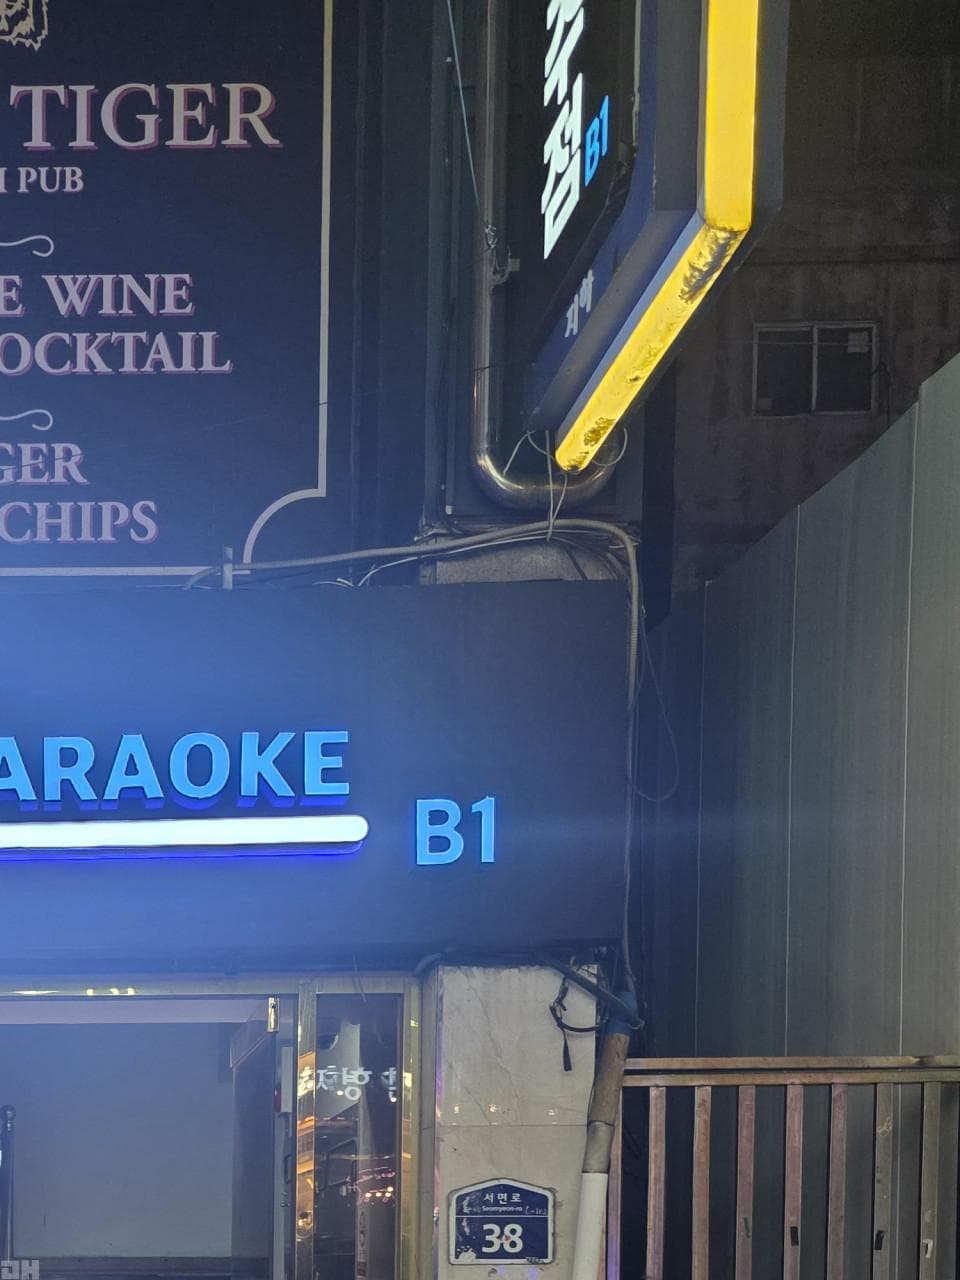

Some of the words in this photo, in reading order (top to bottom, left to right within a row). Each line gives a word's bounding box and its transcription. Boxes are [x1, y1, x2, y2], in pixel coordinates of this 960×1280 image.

[10, 82, 283, 152] TIGER
[585, 95, 609, 187] B1
[17, 166, 84, 194] PUB
[43, 273, 194, 317] WINE
[414, 796, 497, 868] B1
[483, 1192, 522, 1205] 서면로
[481, 1223, 523, 1254] 38
